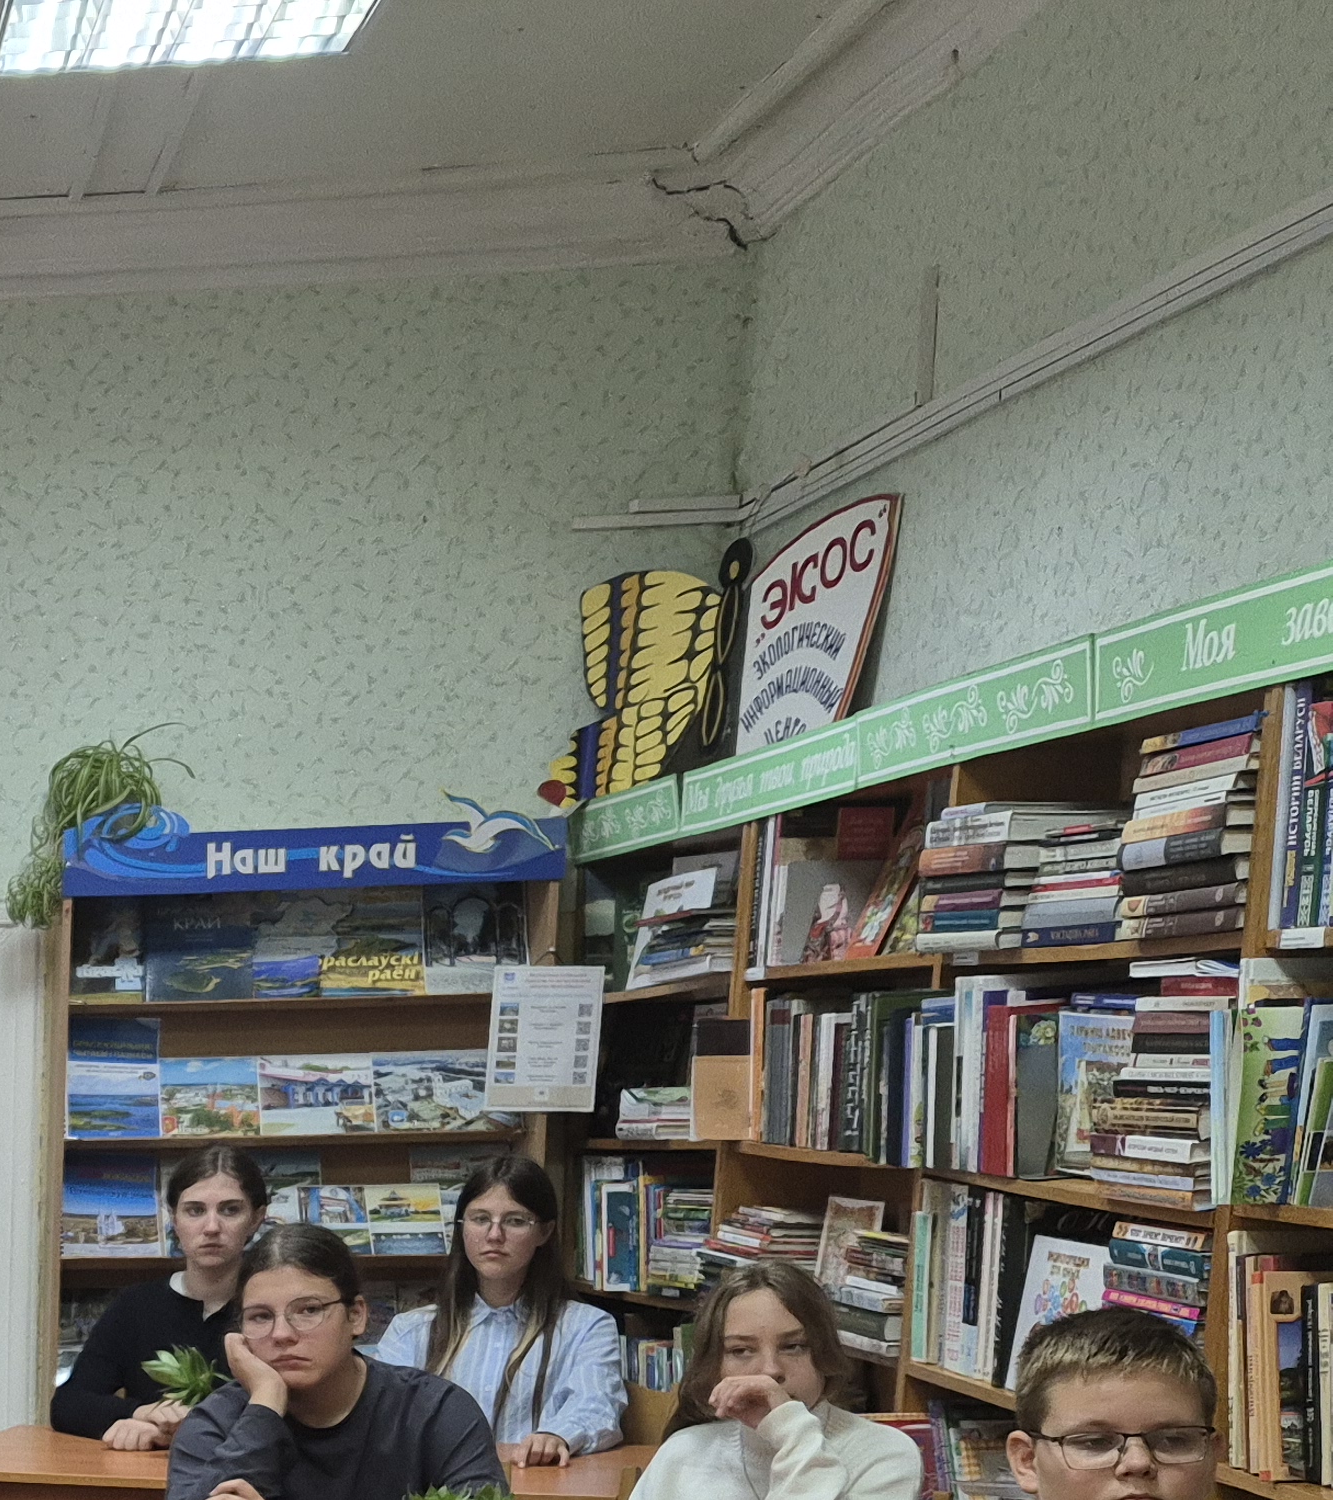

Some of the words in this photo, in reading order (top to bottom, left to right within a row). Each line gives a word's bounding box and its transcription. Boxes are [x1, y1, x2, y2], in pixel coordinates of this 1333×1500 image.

[753, 621, 846, 680] ЭКОЛОГИЧЕСКИЙ
[1181, 618, 1237, 672] Моя
[740, 666, 844, 732] ИНФОРМАЦИОННЫЙ
[206, 841, 287, 878] Наш
[318, 834, 417, 878] край
[368, 966, 416, 983] раён
